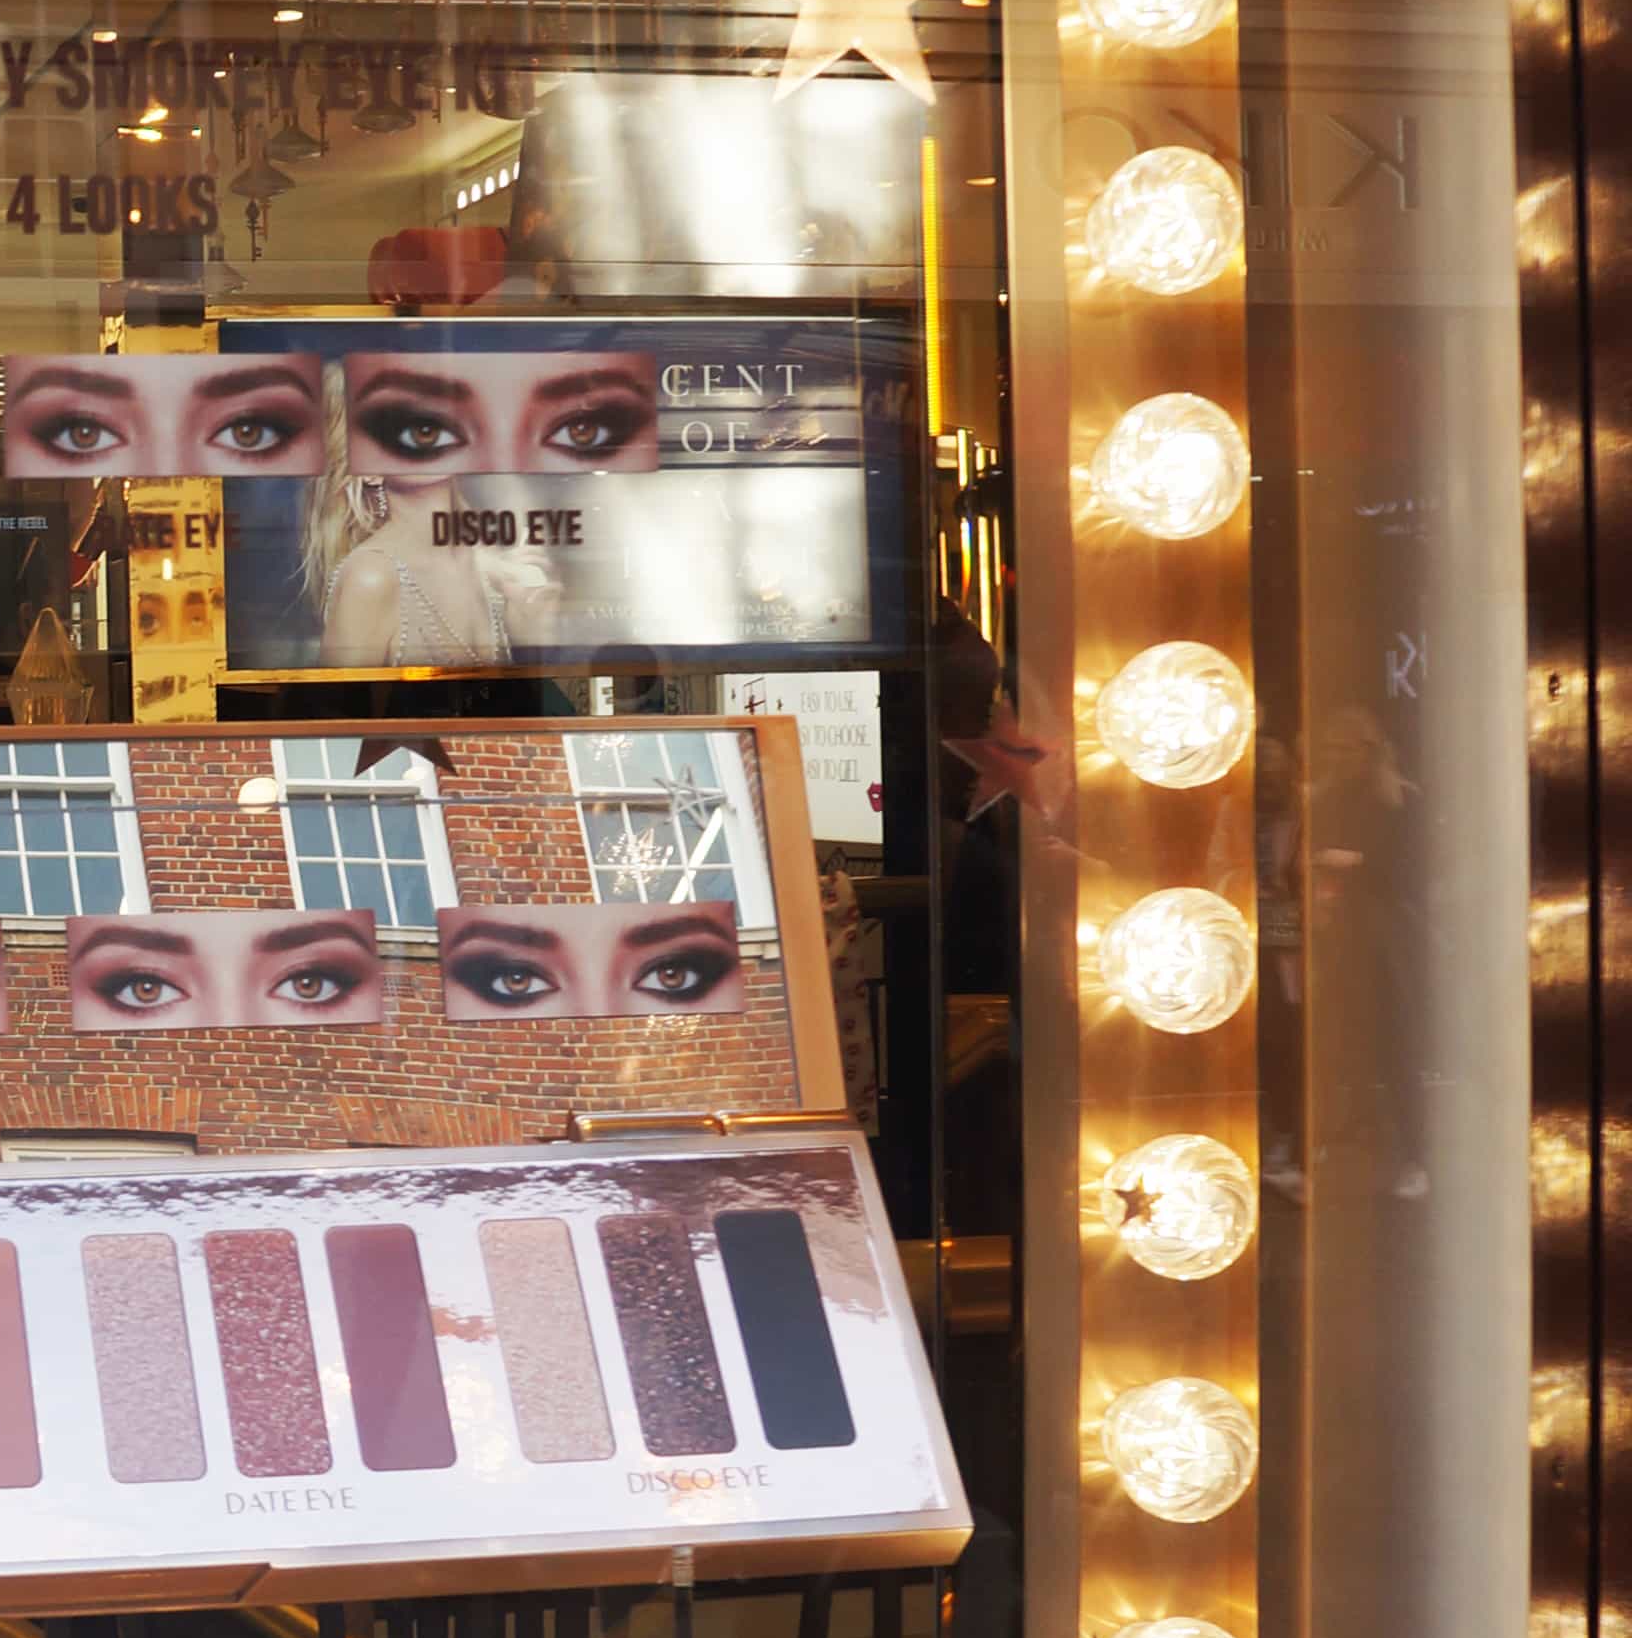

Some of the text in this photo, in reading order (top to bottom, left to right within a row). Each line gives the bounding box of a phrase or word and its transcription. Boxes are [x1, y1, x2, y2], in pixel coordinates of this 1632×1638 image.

[54, 39, 298, 111] SMOKEY
[325, 41, 436, 111] EYE
[6, 175, 219, 237] 4 LOOKS
[433, 510, 584, 547] DISCO EYE
[627, 1465, 773, 1495] DISCO EYE
[225, 1487, 357, 1515] DATE EYE
